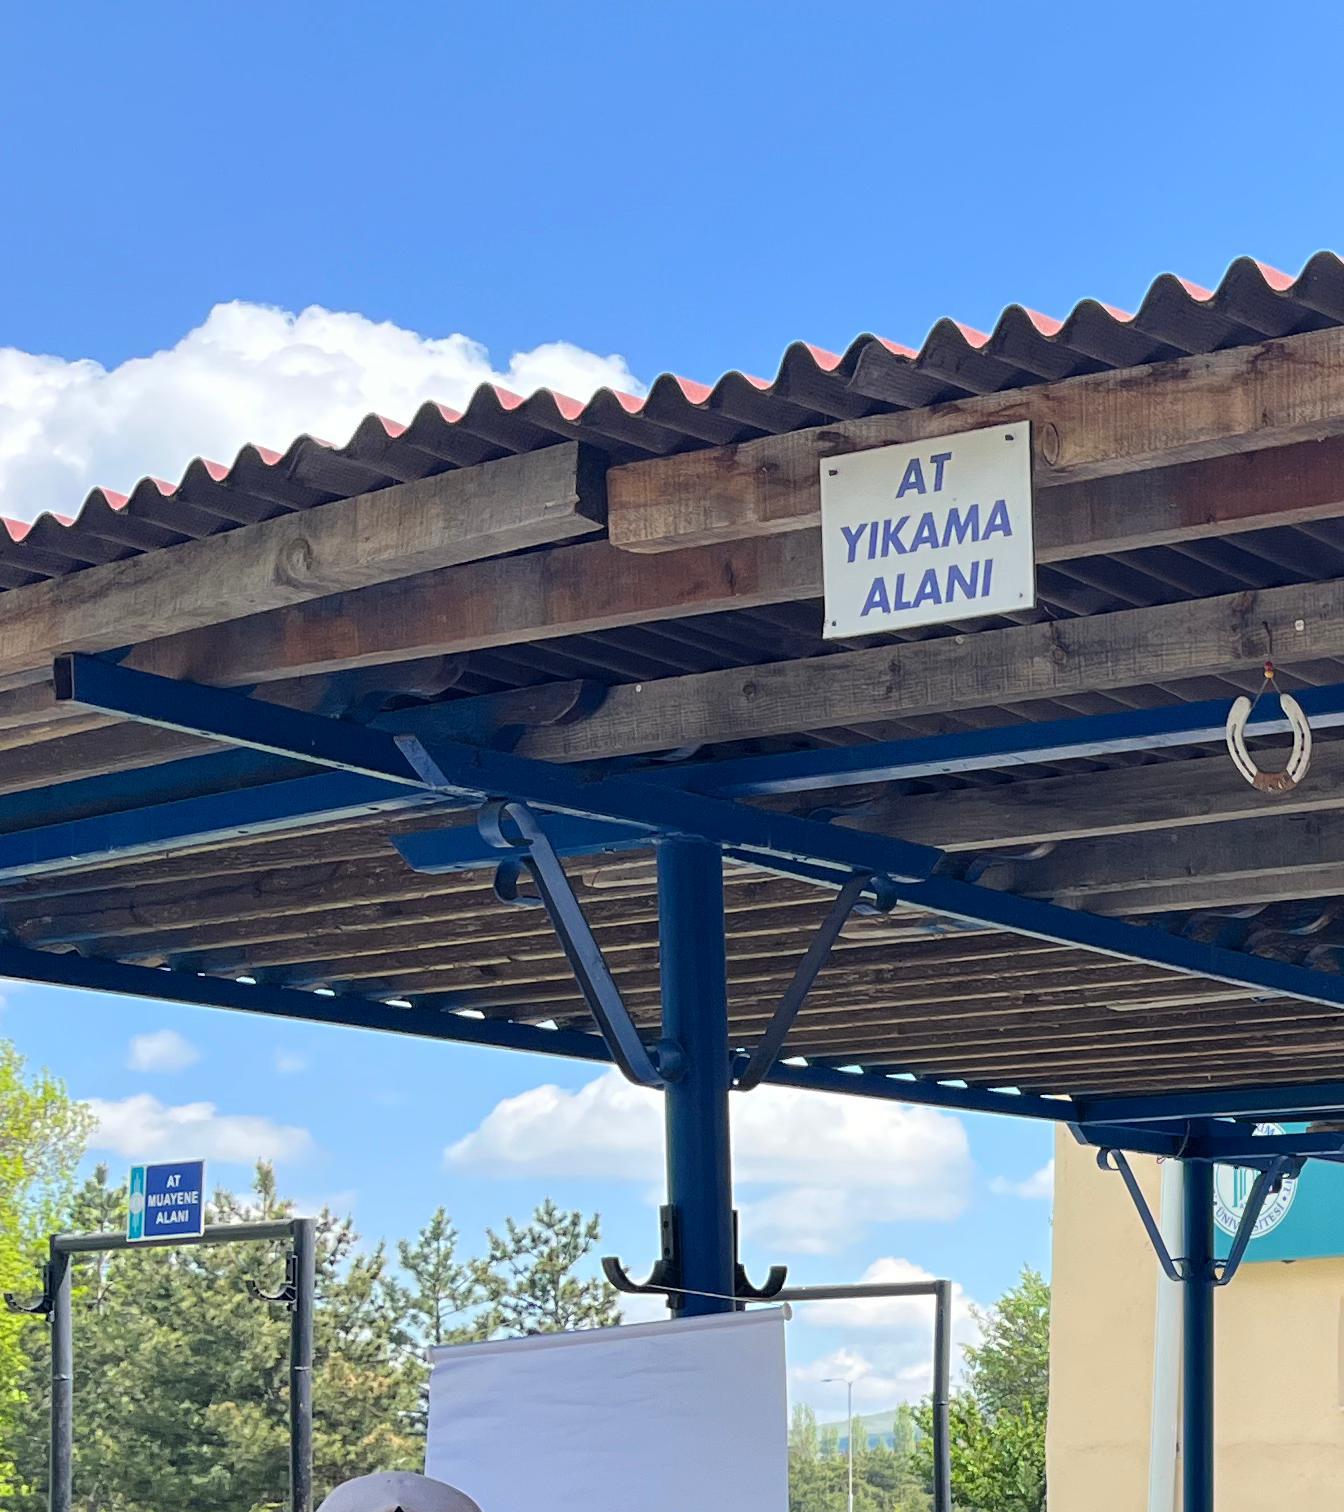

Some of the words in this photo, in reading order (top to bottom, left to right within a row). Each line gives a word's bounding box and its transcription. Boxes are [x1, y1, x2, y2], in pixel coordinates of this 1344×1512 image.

[895, 451, 952, 498] AT
[840, 499, 1012, 563] YIKAMA
[860, 558, 994, 617] ALANI
[166, 1174, 181, 1188] AT
[147, 1191, 199, 1207] MUAYENE
[155, 1210, 189, 1224] ALANI
